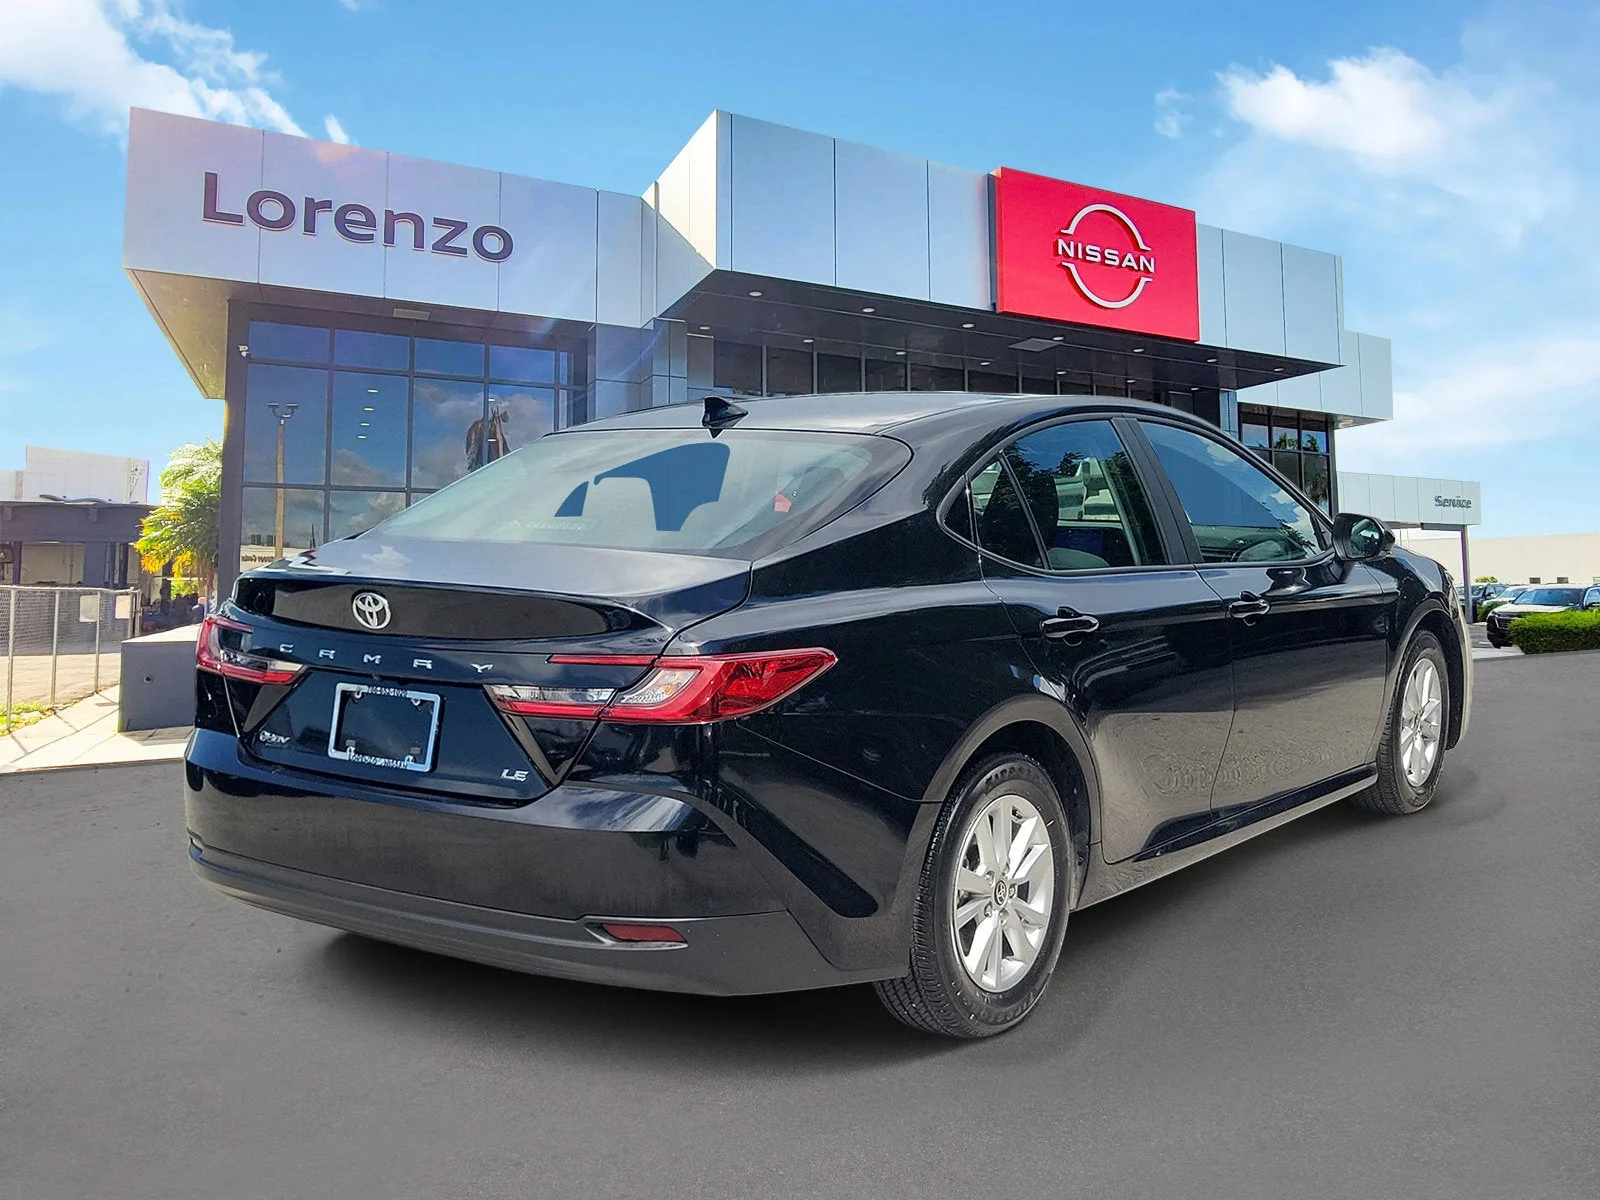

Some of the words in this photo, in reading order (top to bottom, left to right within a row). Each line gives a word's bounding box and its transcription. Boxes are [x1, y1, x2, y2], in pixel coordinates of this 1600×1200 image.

[202, 171, 514, 262] Lorenzo
[1057, 238, 1155, 273] NISSAN
[1434, 495, 1472, 508] Service
[279, 643, 494, 673] CAMRY
[500, 768, 529, 781] LE
